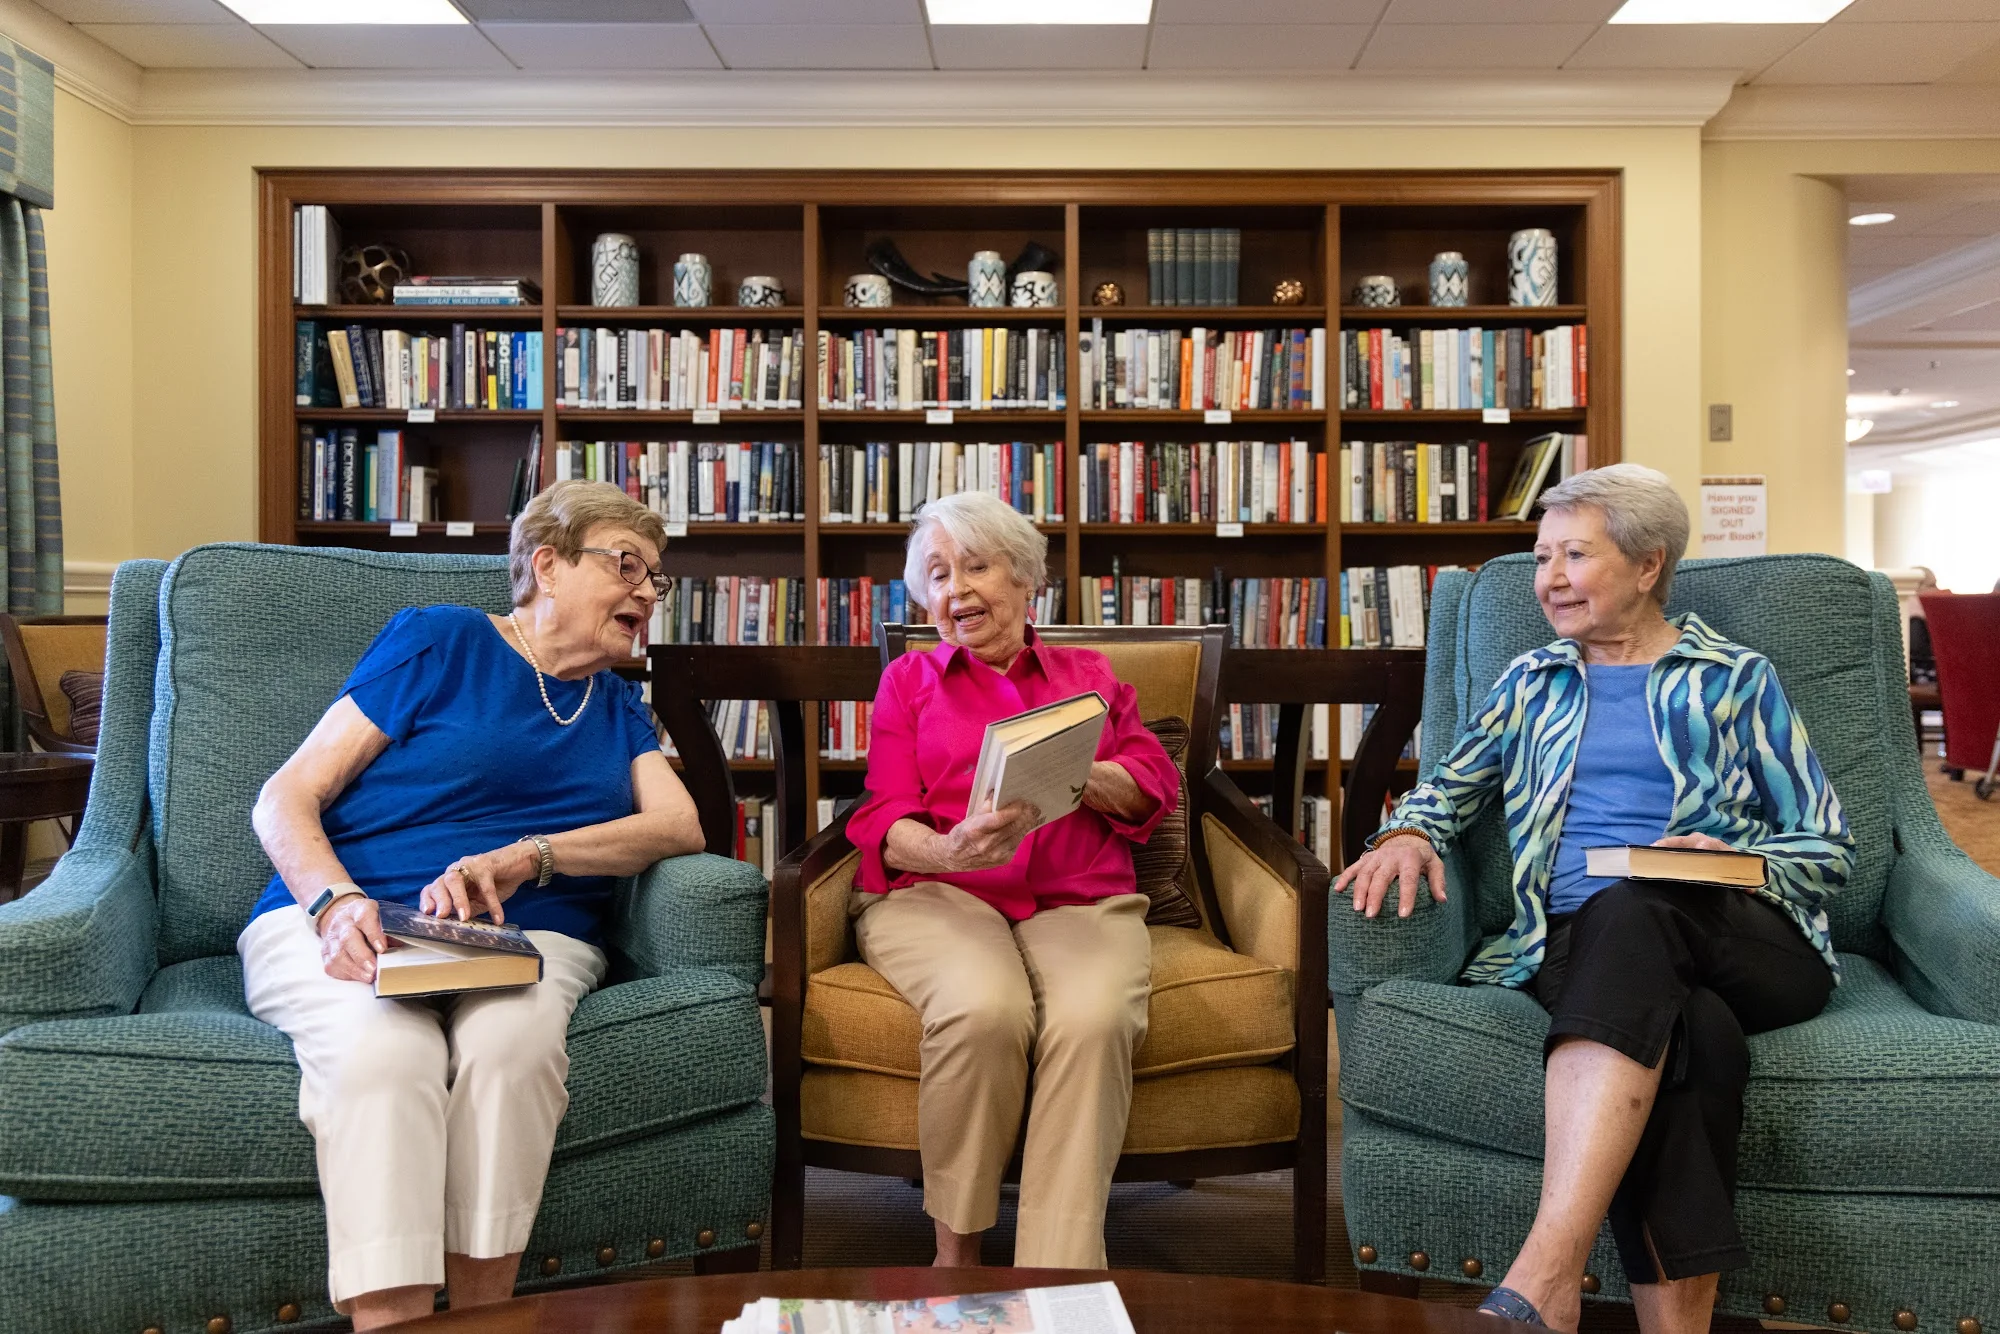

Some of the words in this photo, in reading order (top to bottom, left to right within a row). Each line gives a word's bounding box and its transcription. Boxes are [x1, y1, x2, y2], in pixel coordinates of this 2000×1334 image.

[499, 334, 510, 364] 501
[343, 443, 353, 507] DICTIONARY
[1405, 476, 1415, 511] LINCOLN
[1707, 493, 1735, 502] Have
[1738, 495, 1757, 503] you
[1710, 506, 1754, 515] SIGNED
[1720, 519, 1745, 528] OUT
[1701, 533, 1725, 543] your
[1728, 531, 1763, 541] Book?
